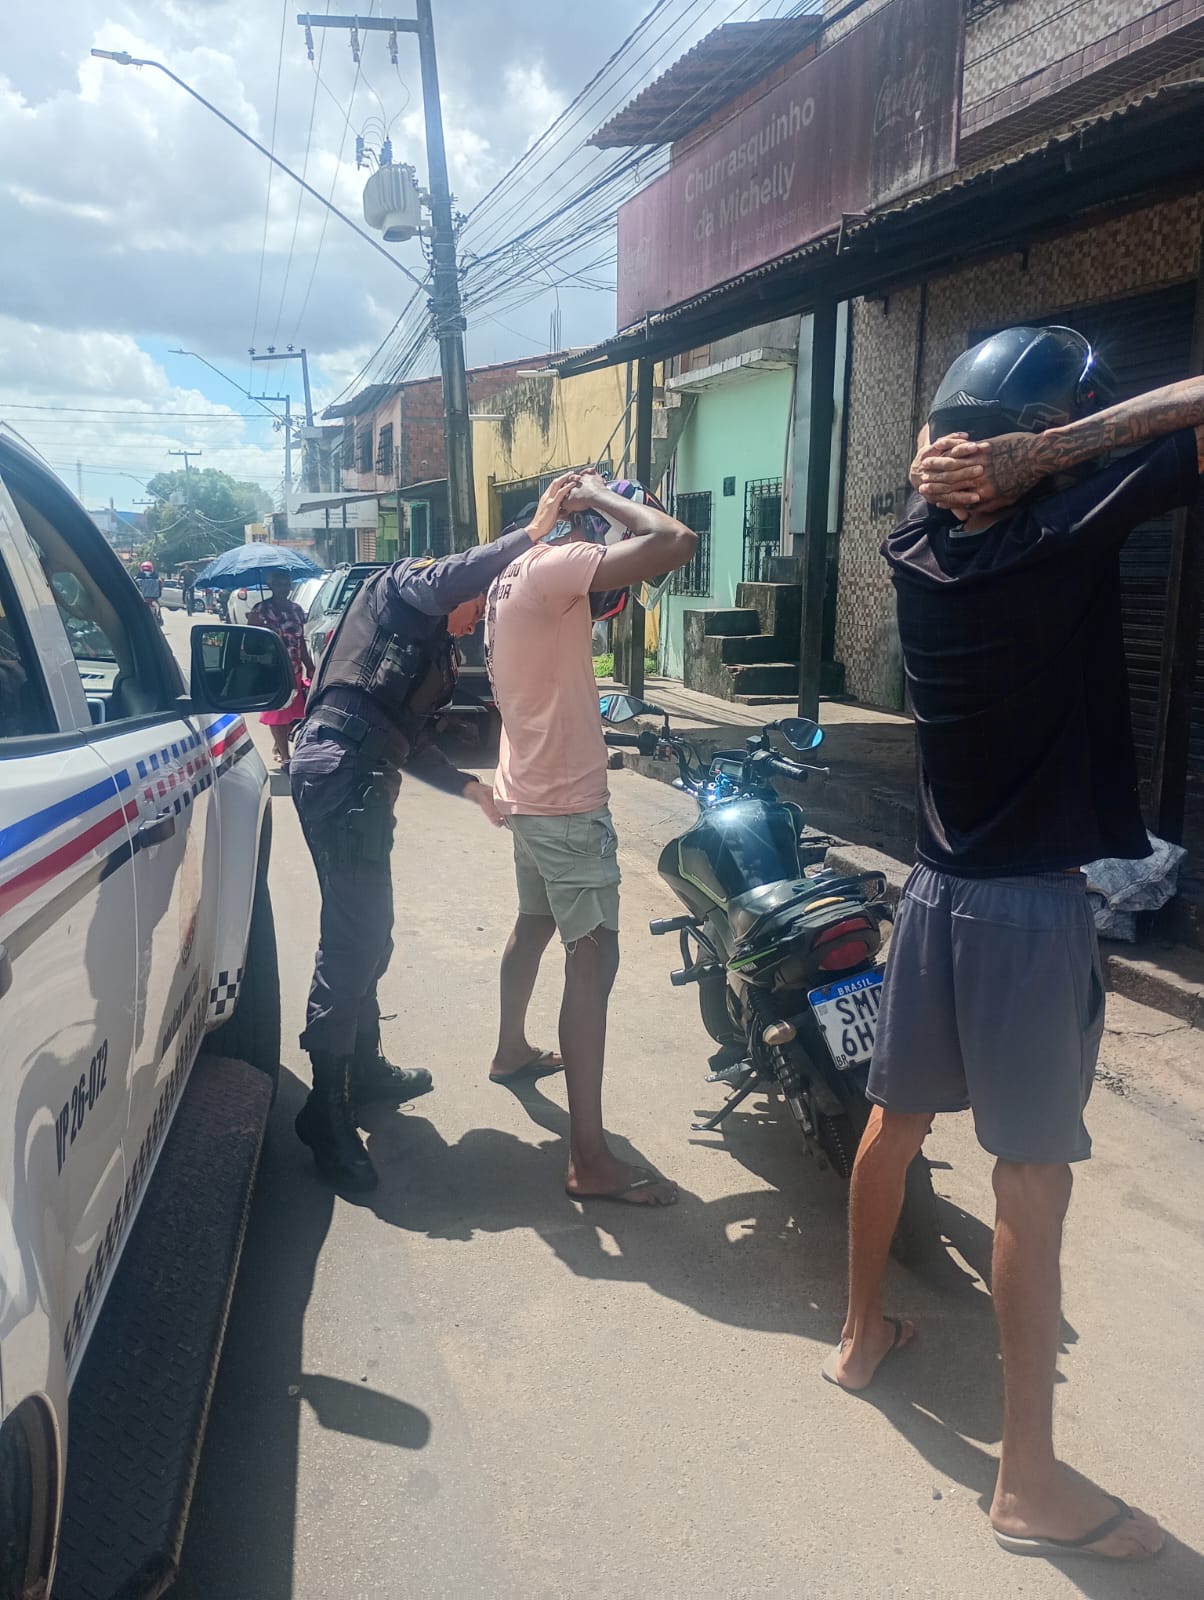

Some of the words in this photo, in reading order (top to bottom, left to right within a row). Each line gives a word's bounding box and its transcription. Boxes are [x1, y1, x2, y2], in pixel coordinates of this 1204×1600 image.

[684, 96, 816, 202] Churrasquinho
[694, 206, 714, 241] da
[719, 161, 796, 230] Michelly
[838, 978, 873, 995] BRASIL
[836, 1054, 848, 1066] BR
[842, 1020, 877, 1056] 6H
[56, 1101, 69, 1176] VP
[70, 1039, 108, 1146] 26-072
